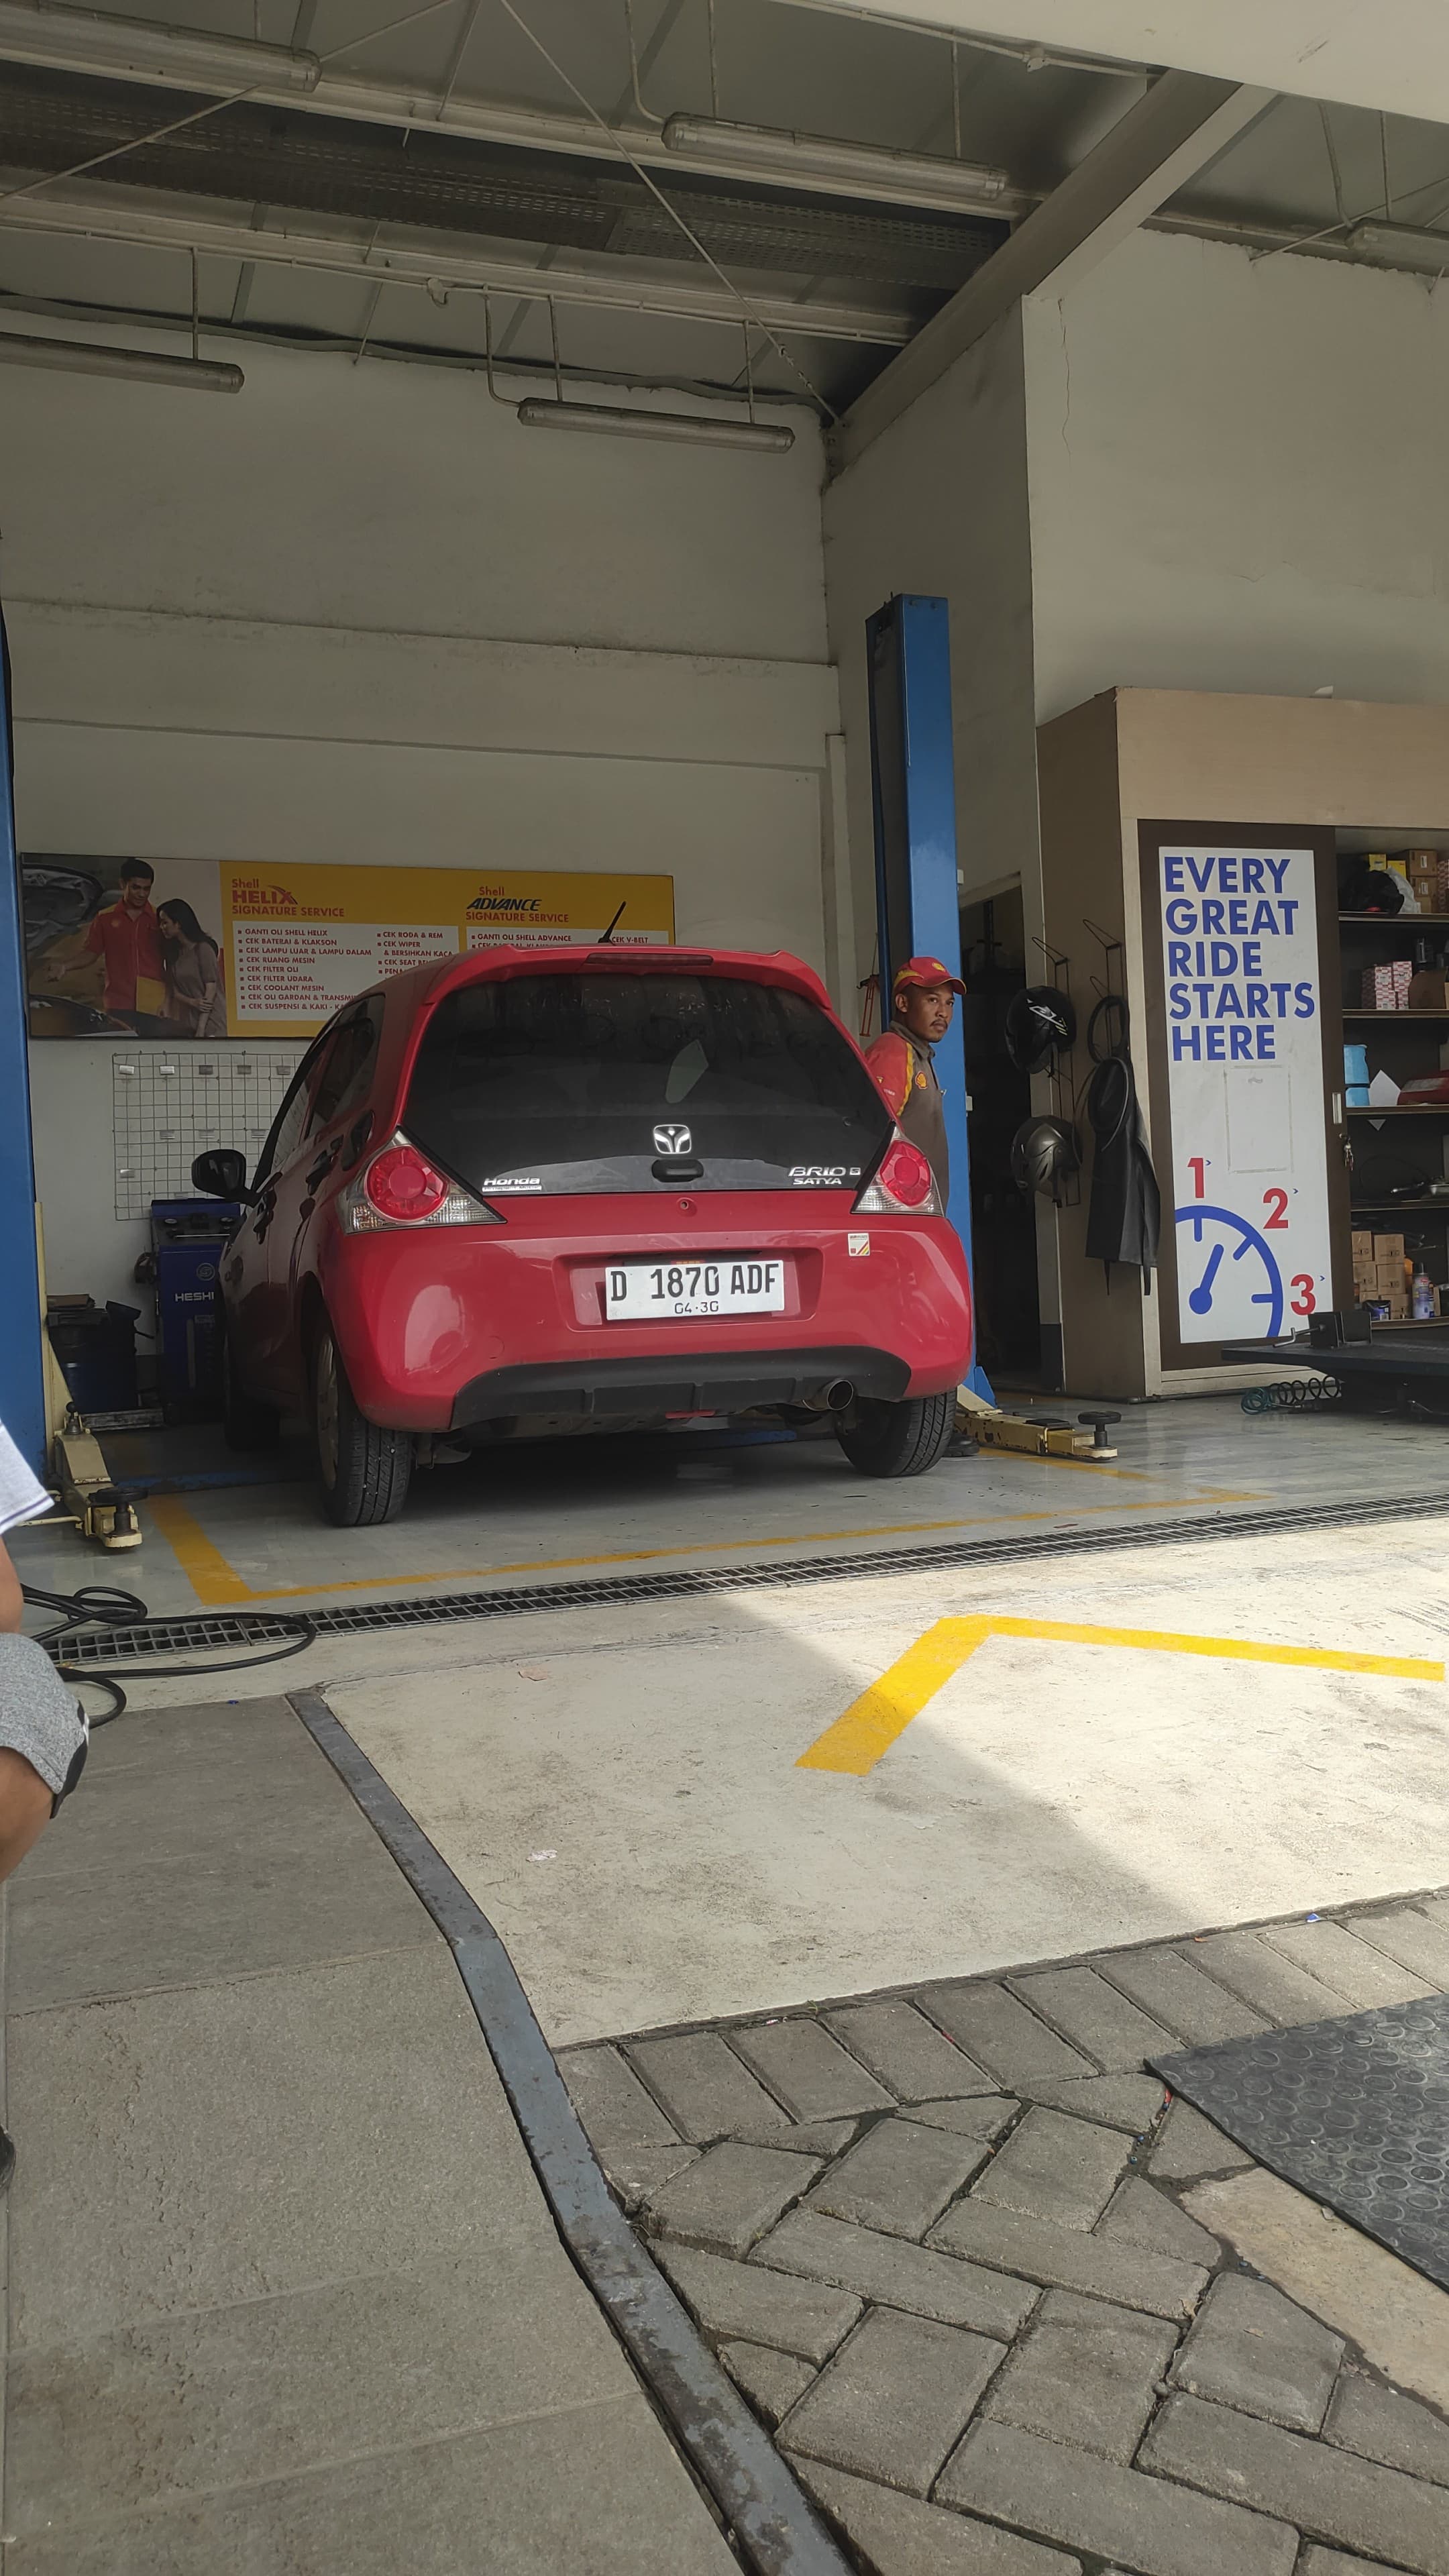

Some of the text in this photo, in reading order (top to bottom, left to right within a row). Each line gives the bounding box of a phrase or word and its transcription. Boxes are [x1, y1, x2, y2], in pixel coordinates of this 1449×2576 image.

[231, 878, 259, 888] Shell
[479, 885, 504, 896] Shell
[1164, 856, 1291, 894] EVERY
[232, 890, 296, 904] HELIX
[232, 906, 344, 917] SIGNATURE SERVICE
[467, 898, 542, 911] ADVANCE
[466, 912, 569, 923] SIGNATURE SERVICE
[1166, 898, 1299, 935] GREAT
[1168, 941, 1262, 977] RIDE
[1169, 982, 1315, 1020] STARTS
[1172, 1024, 1276, 1061] HERE
[484, 1177, 541, 1185] Honda
[788, 1167, 846, 1177] BRIO
[1187, 1158, 1204, 1198] 1
[1263, 1187, 1288, 1229] 2
[610, 1263, 779, 1301] D 1870 ADF
[1291, 1274, 1316, 1316] 3
